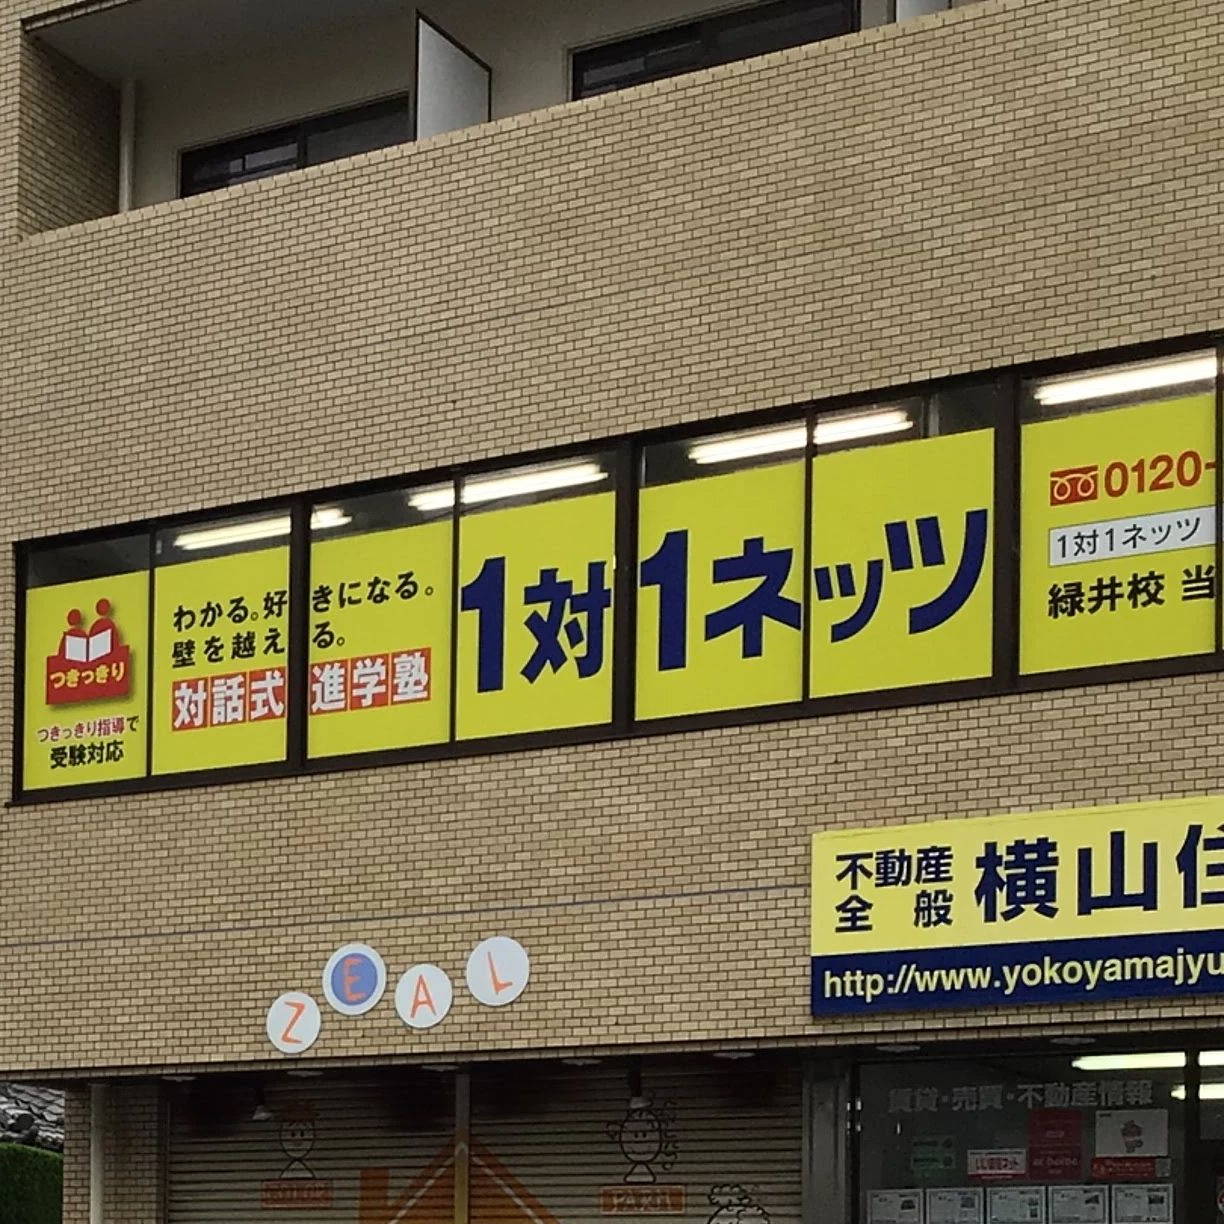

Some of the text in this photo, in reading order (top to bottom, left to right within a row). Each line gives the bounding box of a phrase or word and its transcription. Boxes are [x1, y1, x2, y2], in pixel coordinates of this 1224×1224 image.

[1057, 517, 1200, 558] 1対1ネッツ
[461, 508, 988, 694] 1対1ネッツ
[1048, 571, 1165, 619] 緑井校
[50, 663, 125, 690] つきっきり
[37, 716, 140, 743] つきっきり指導で
[49, 739, 125, 770] 受験対応
[835, 845, 954, 890] 不動産
